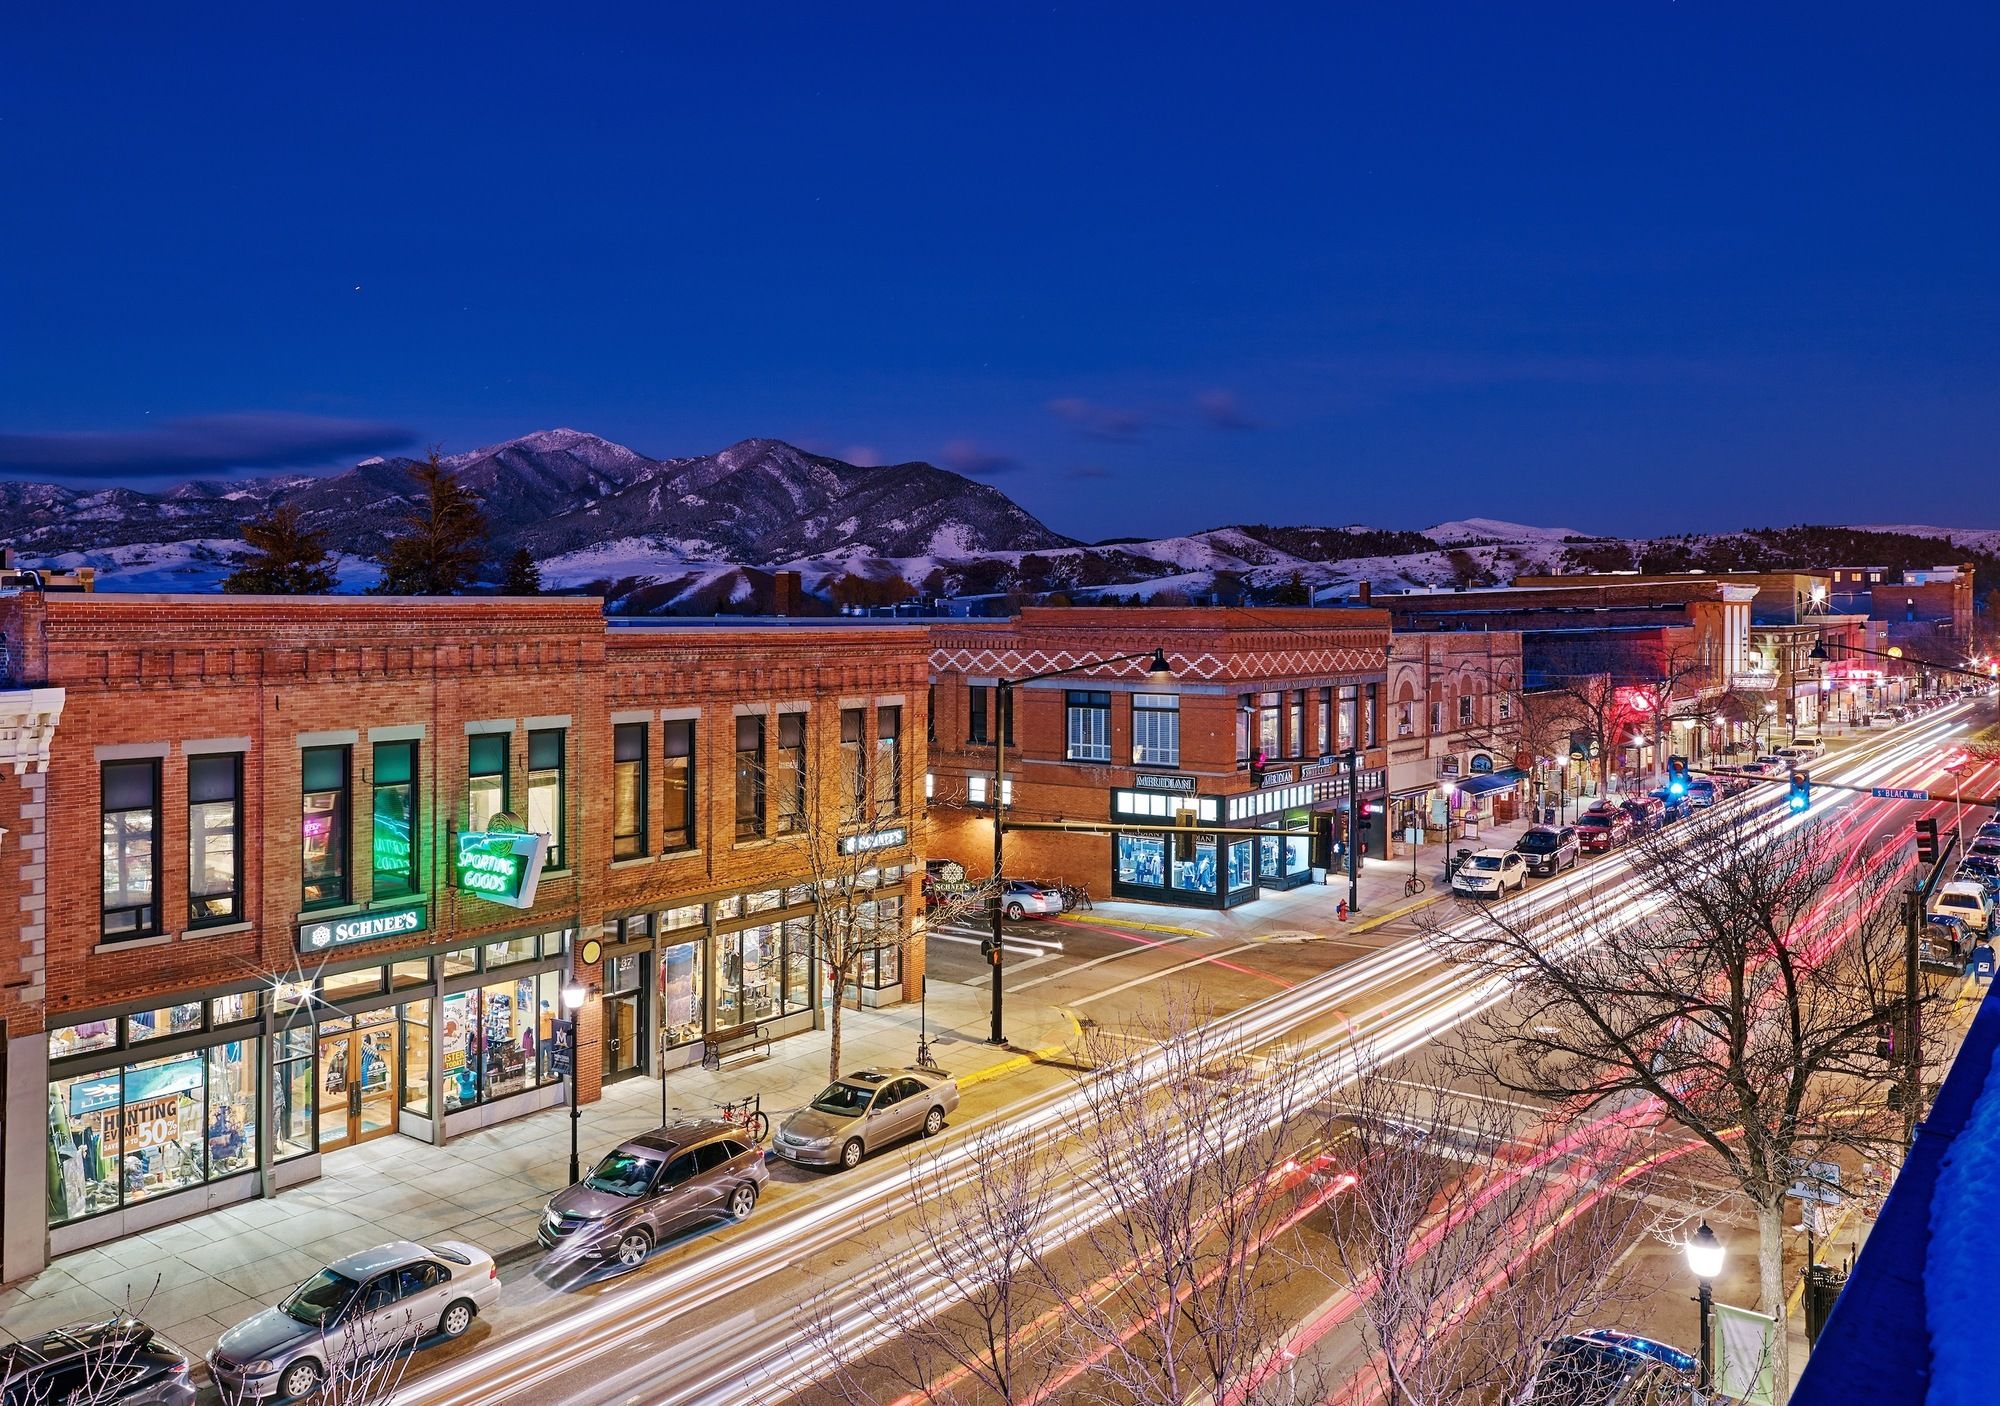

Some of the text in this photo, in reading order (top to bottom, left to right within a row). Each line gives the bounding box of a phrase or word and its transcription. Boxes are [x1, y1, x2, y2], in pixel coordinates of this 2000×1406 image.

[1319, 676, 1362, 687] COMPANY
[1136, 776, 1192, 790] MERIDIAN
[1263, 770, 1292, 787] MERIDIAN
[1885, 789, 1909, 798] BLACK
[457, 852, 515, 876] SPORTING
[464, 870, 507, 892] GOODS
[336, 911, 418, 942] SCHNEE'S
[103, 1125, 139, 1142] EVNT
